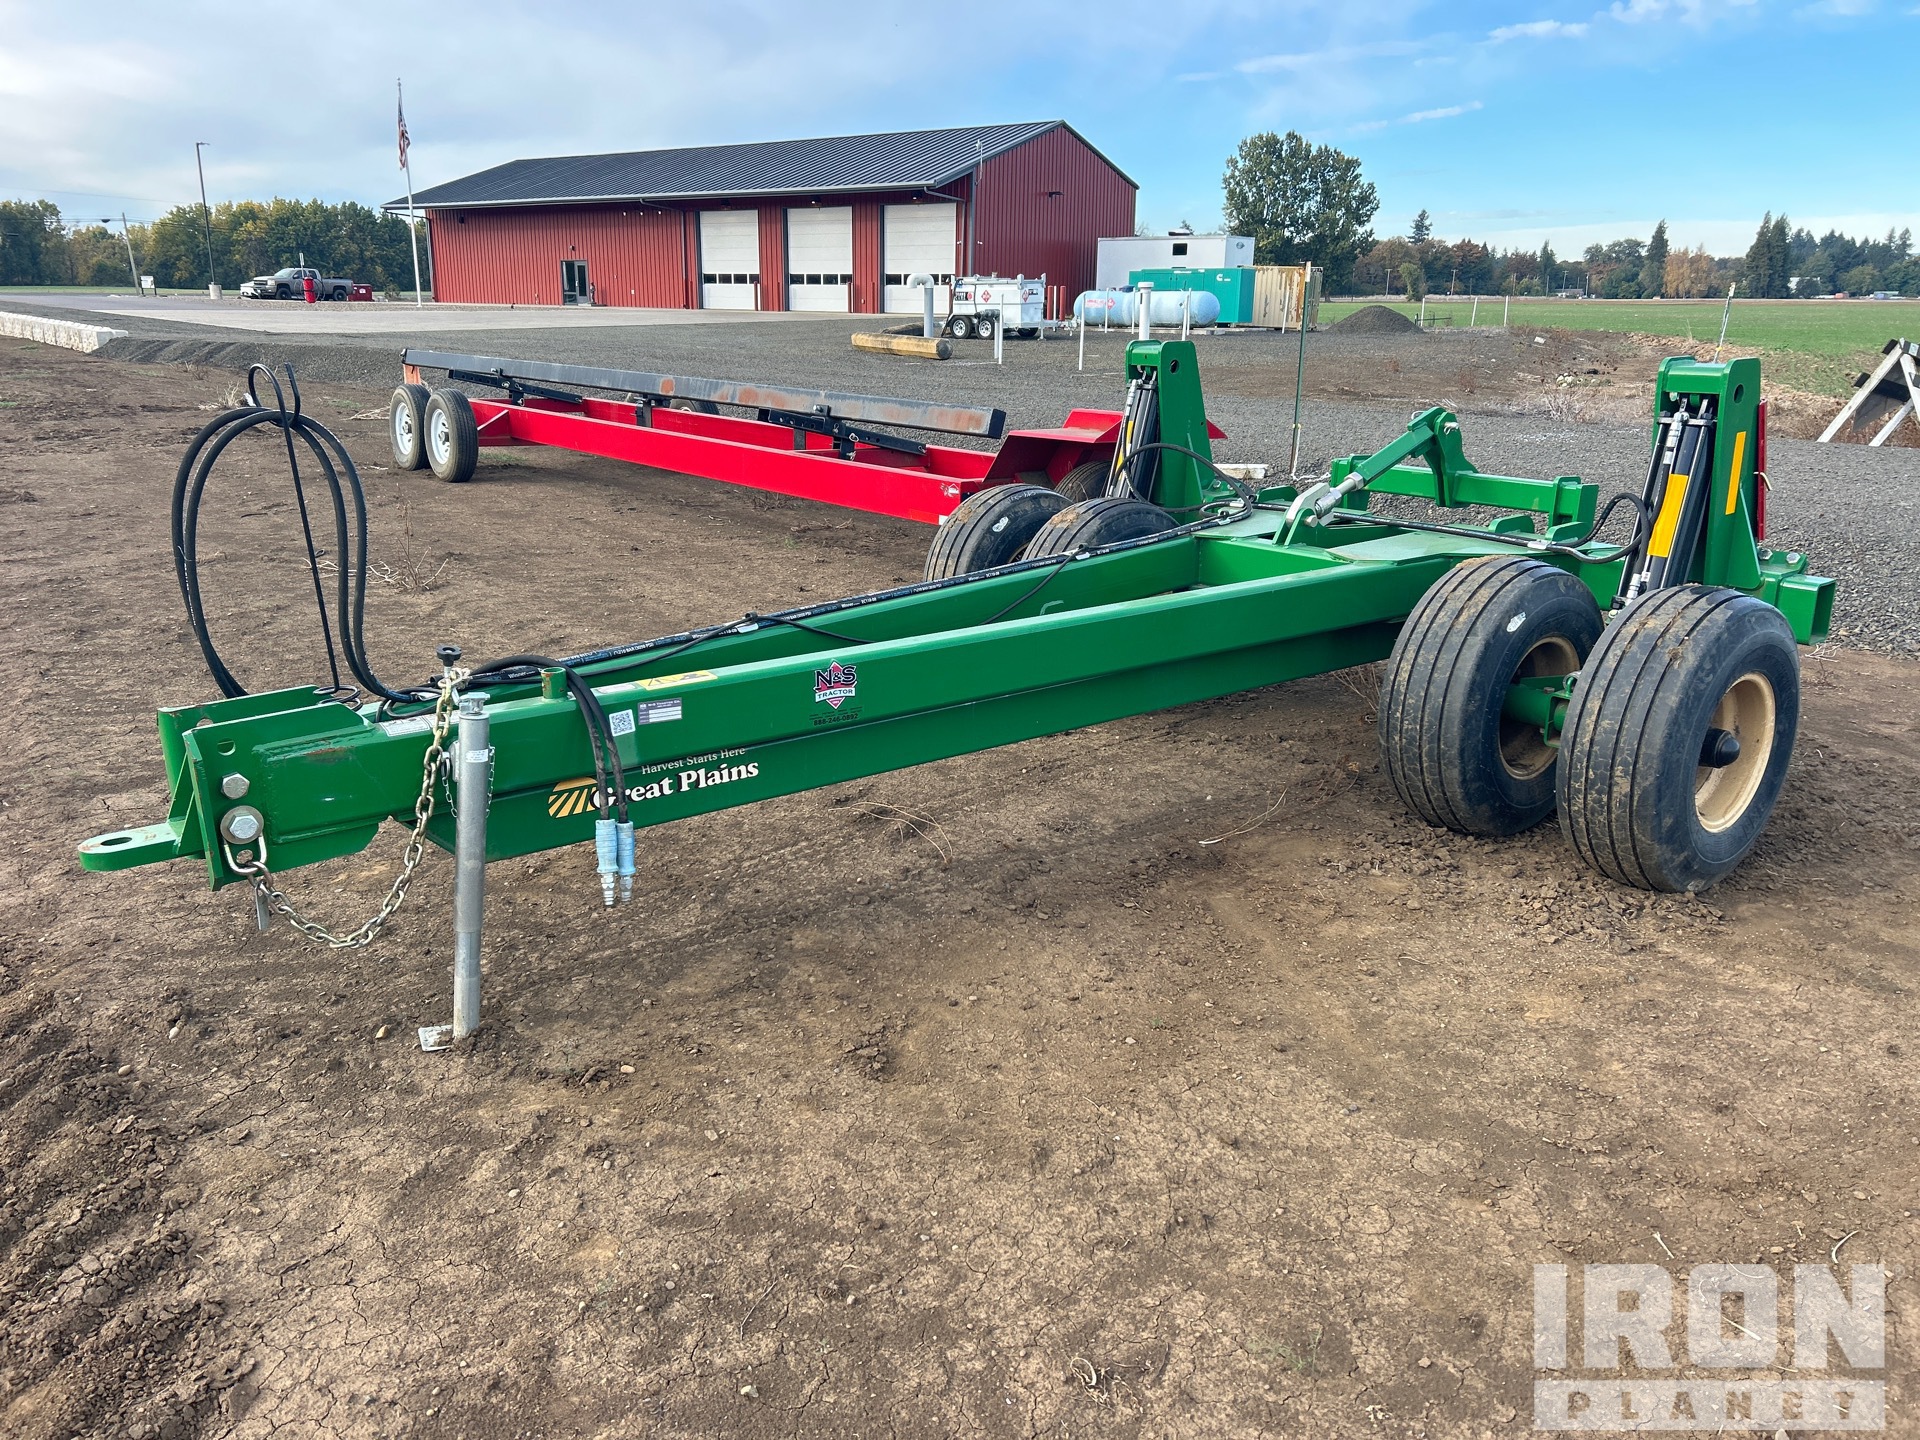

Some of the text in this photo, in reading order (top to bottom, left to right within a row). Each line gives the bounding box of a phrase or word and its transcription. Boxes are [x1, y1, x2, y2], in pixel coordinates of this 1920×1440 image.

[815, 665, 857, 688] N&S
[817, 689, 854, 699] TRACTOR
[641, 747, 746, 775] Harvest Starts Here
[677, 761, 760, 792] Plains
